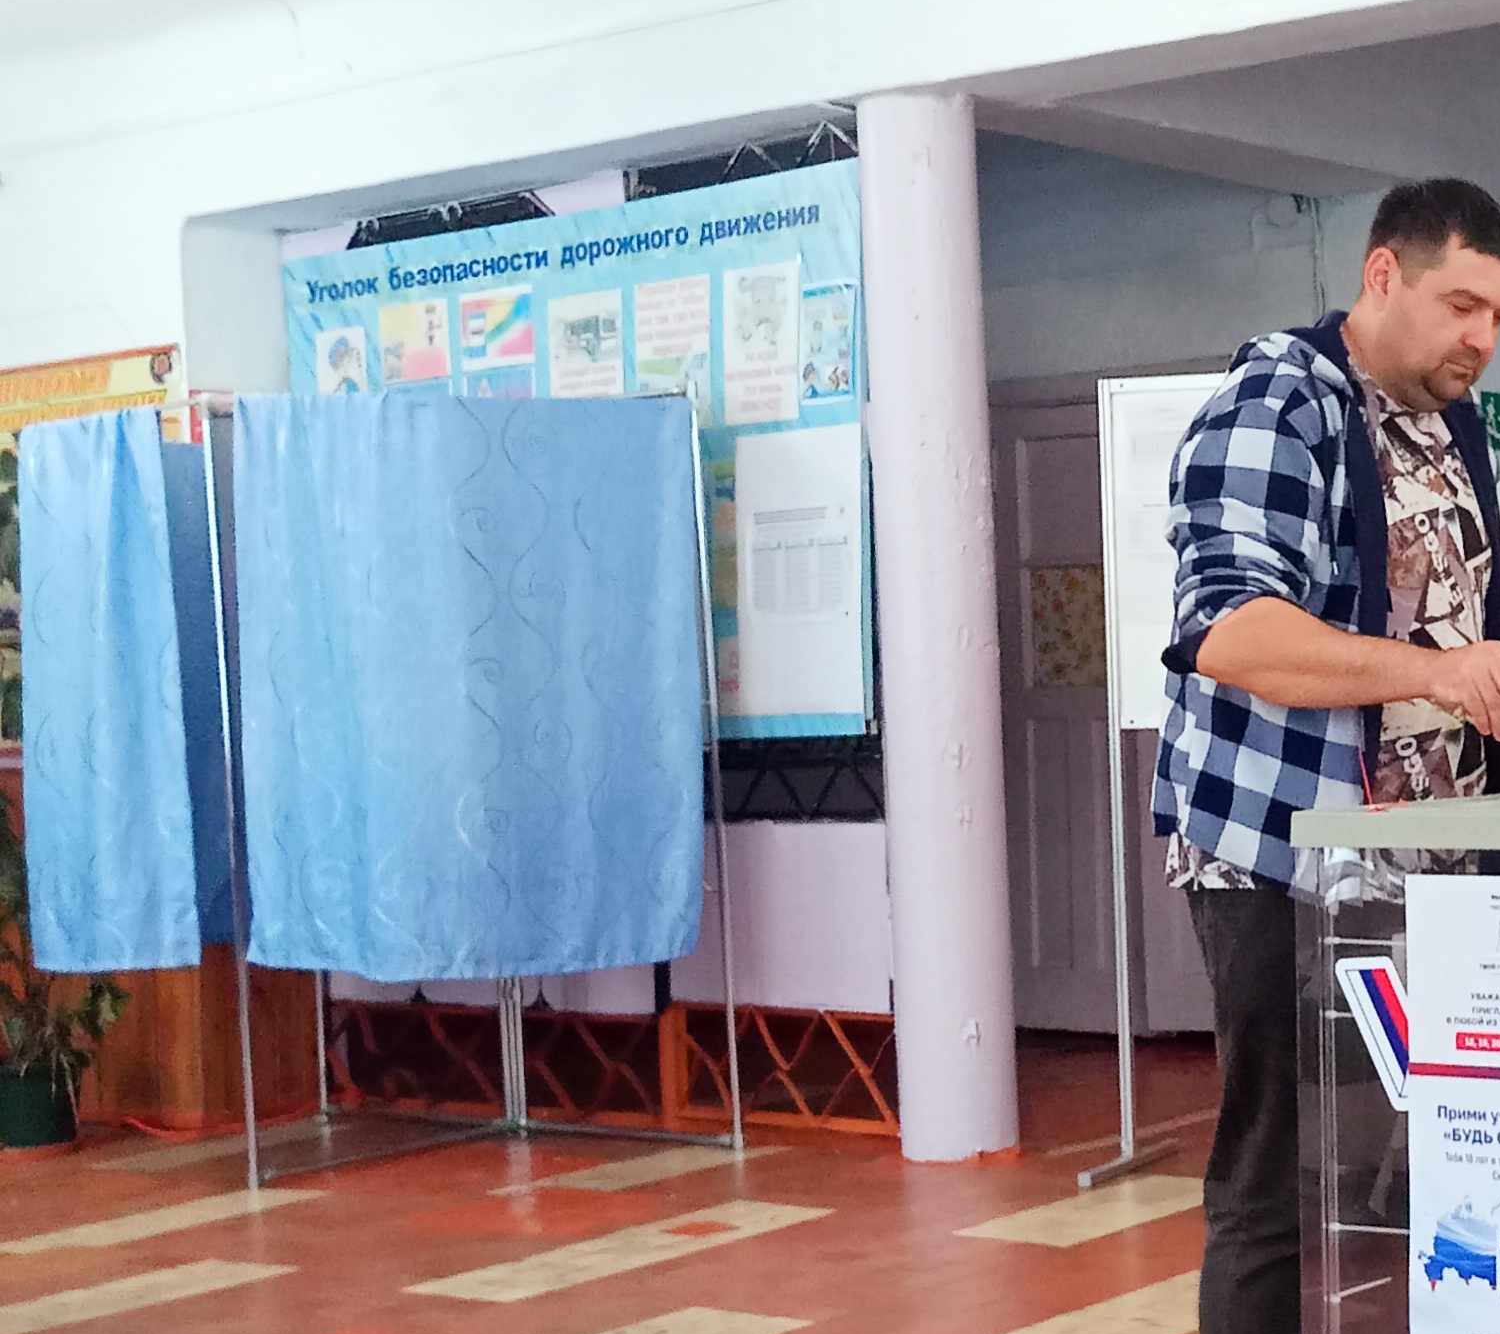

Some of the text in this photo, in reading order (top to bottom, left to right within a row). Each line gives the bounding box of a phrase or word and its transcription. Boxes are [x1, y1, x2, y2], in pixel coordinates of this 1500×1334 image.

[306, 203, 821, 304] Уголок безопасности дорожного движения
[1454, 1016, 1485, 1026] ЛЮБОЙ
[1437, 1104, 1487, 1122] Прими
[1443, 1127, 1494, 1146] «БУДЬ
